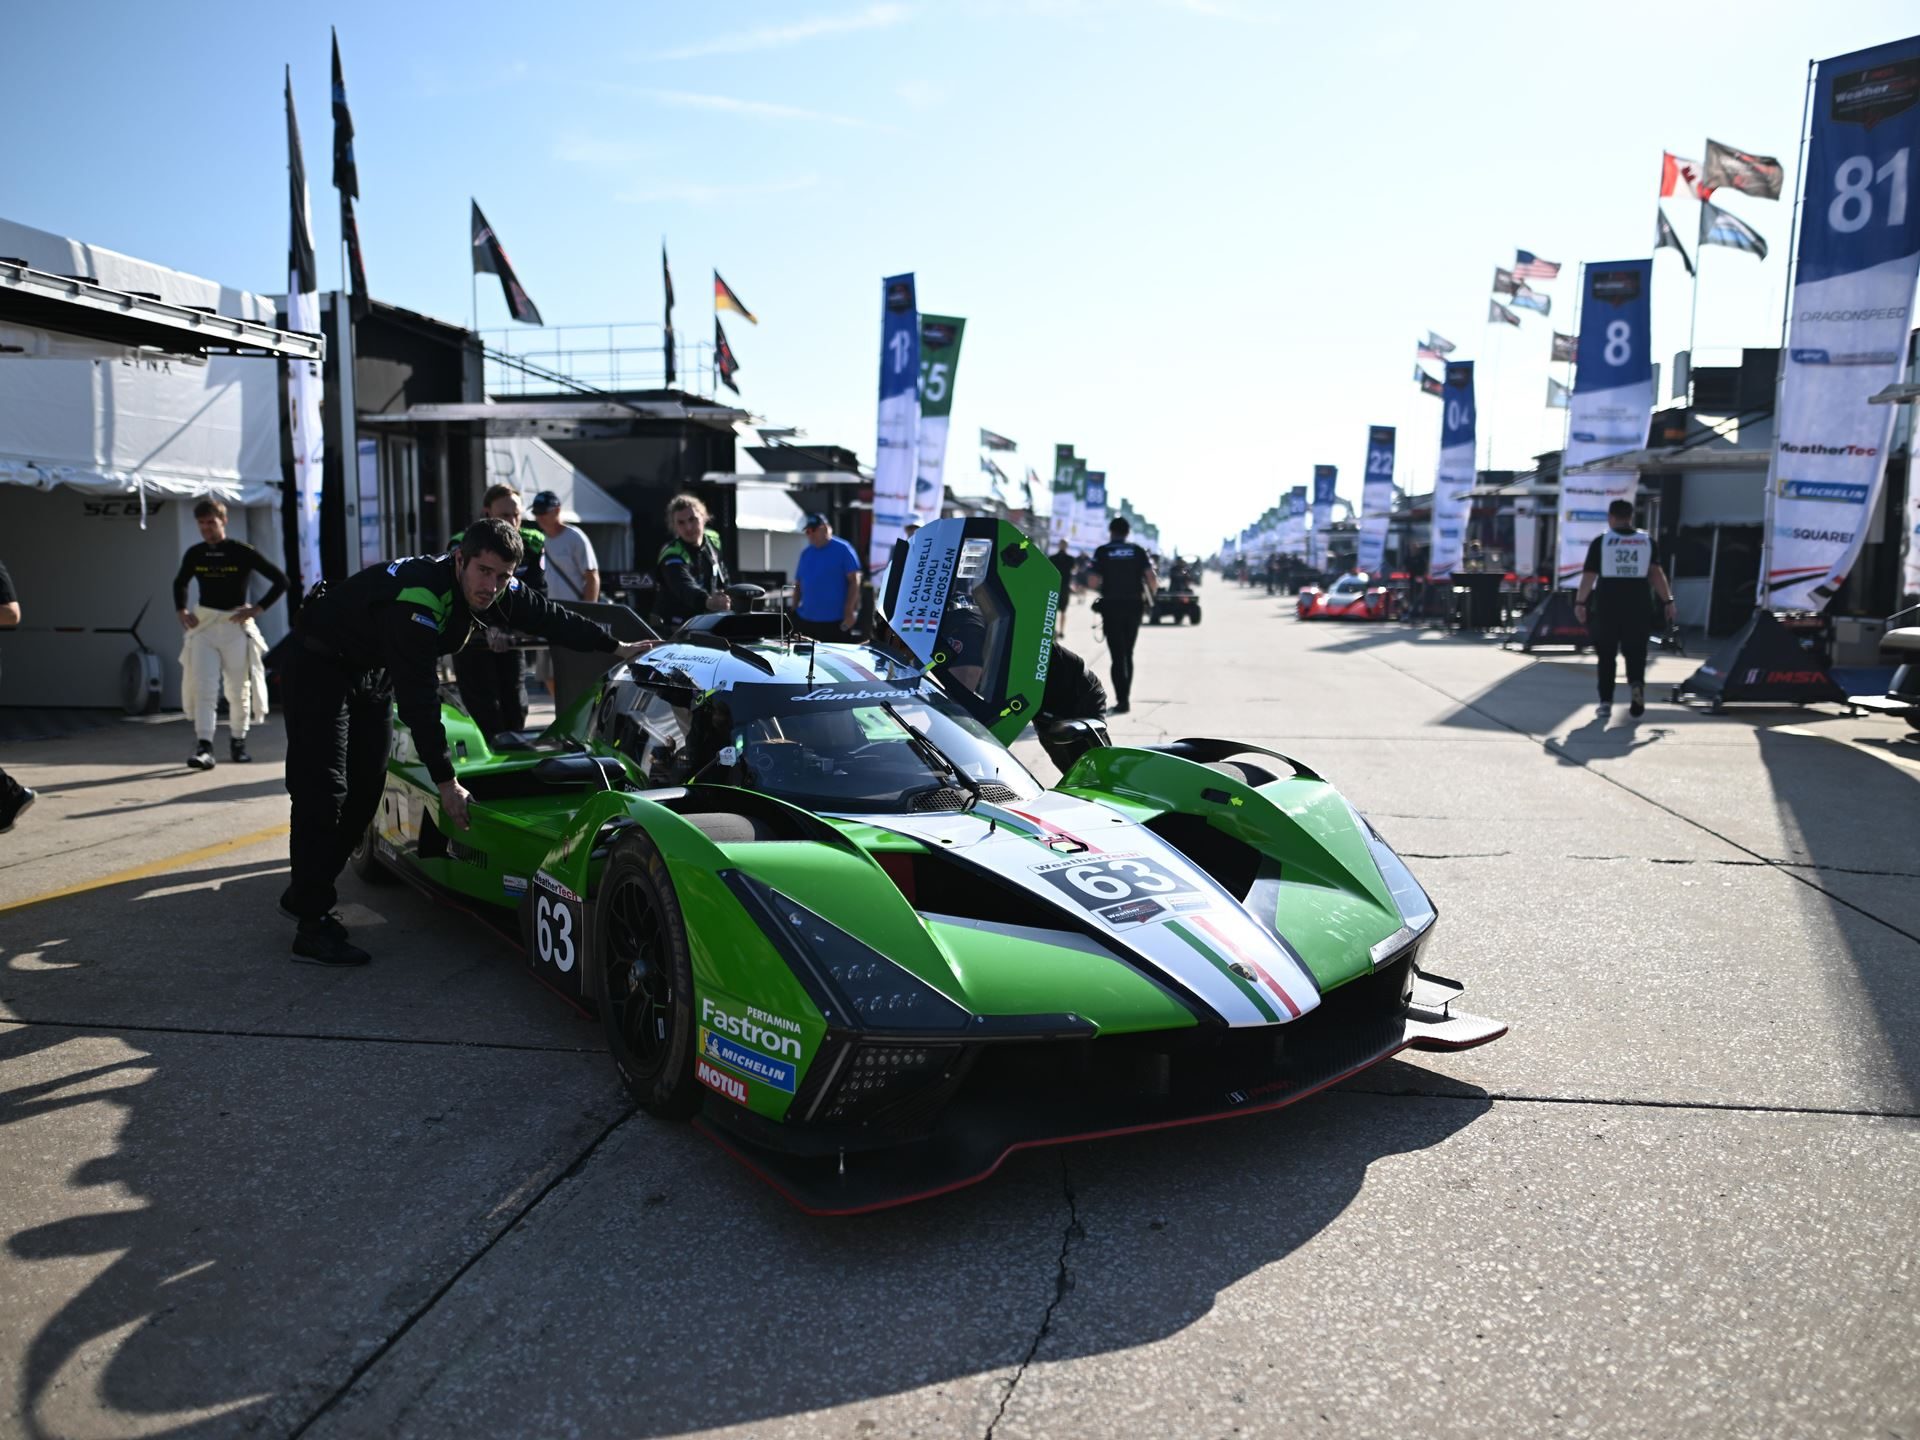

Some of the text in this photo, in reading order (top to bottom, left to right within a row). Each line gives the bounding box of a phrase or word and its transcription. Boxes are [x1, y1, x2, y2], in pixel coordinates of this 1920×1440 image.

[1828, 147, 1910, 233] 81
[1800, 307, 1906, 322] DRAGONSPEED
[1604, 320, 1631, 367] 8
[1369, 452, 1393, 474] 22
[1800, 487, 1865, 499] MICHELIN
[909, 538, 933, 603] CALDARELLI
[1615, 549, 1639, 563] 324
[1616, 565, 1639, 576] VIDEO
[920, 559, 940, 602] CAIROLI
[933, 548, 956, 605] GROSJEAN
[1035, 590, 1059, 682] ROGER DUBUIS
[1767, 671, 1828, 683] IMSA
[1034, 852, 1141, 873] WeatherTech
[1065, 860, 1177, 900] 63
[534, 872, 578, 901] WeatherTech
[537, 895, 575, 973] 63
[702, 998, 802, 1060] Fastron
[747, 1006, 802, 1034] PERTAMINA
[698, 1062, 747, 1102] MOTUL
[721, 1047, 786, 1081] MICHELIN
